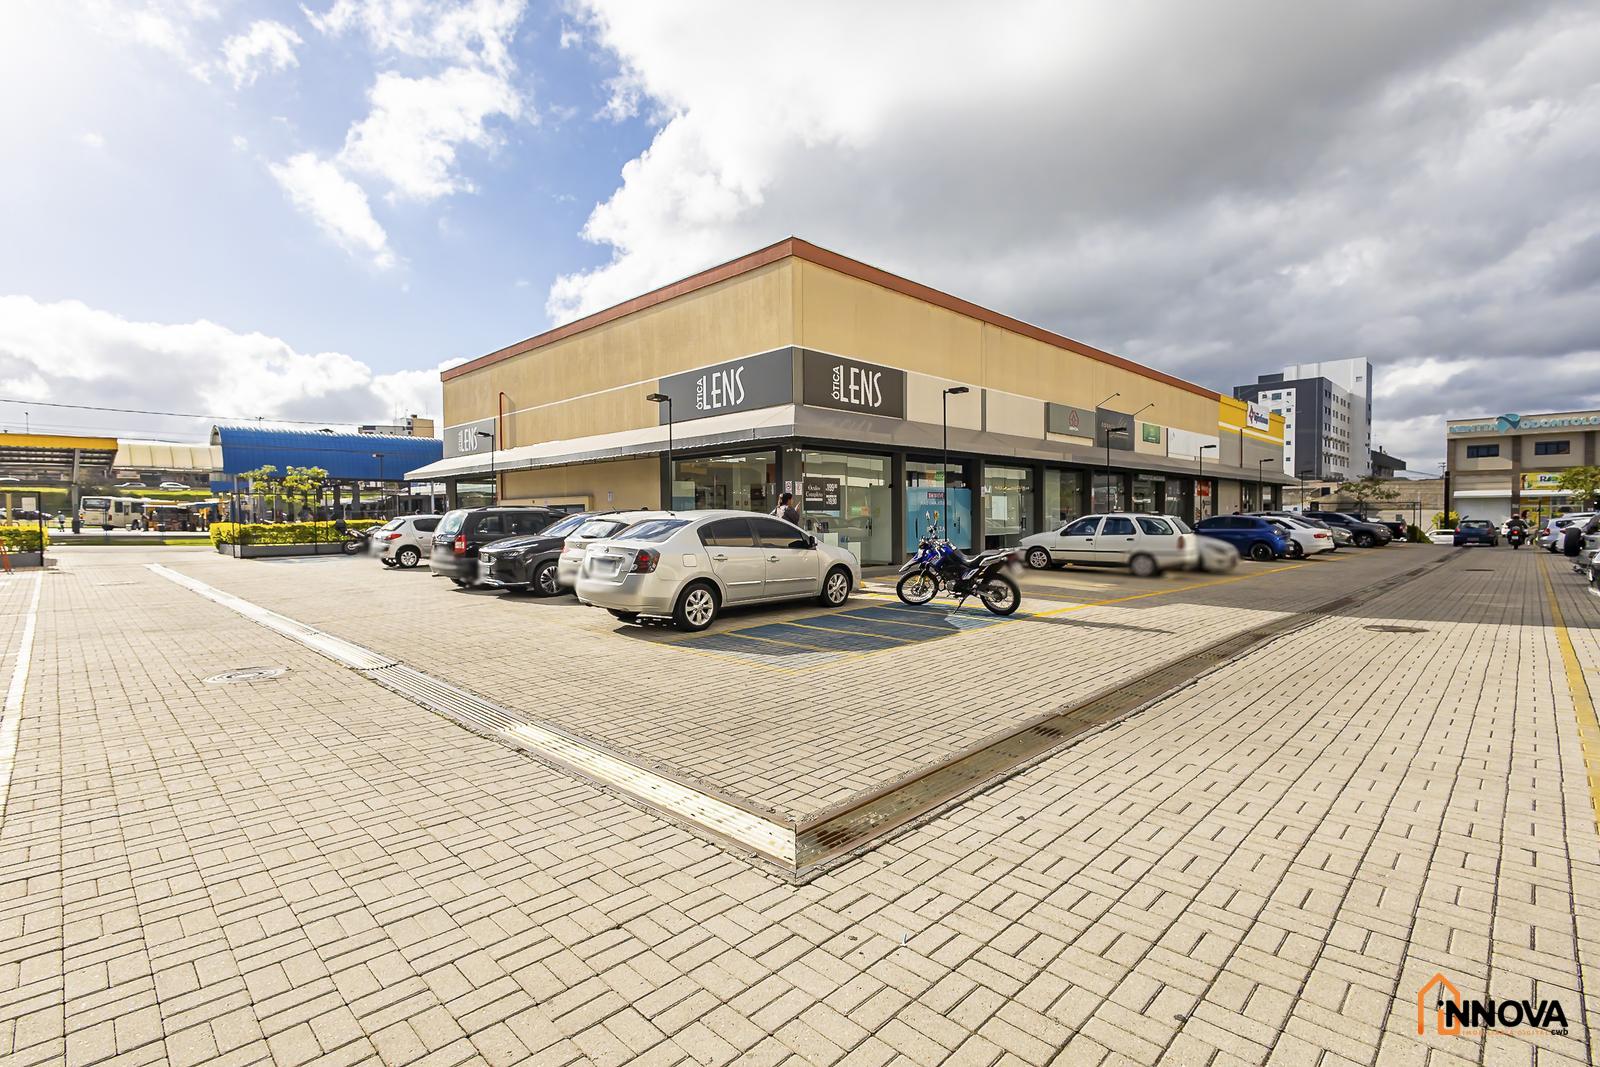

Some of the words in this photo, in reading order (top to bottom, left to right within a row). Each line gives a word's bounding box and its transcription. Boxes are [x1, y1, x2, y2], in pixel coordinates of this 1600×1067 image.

[695, 378, 703, 409] ÓTICA
[703, 365, 745, 411] LENS
[831, 365, 840, 400] ÓTICA
[839, 364, 882, 408] LENS
[461, 426, 478, 452] LENS
